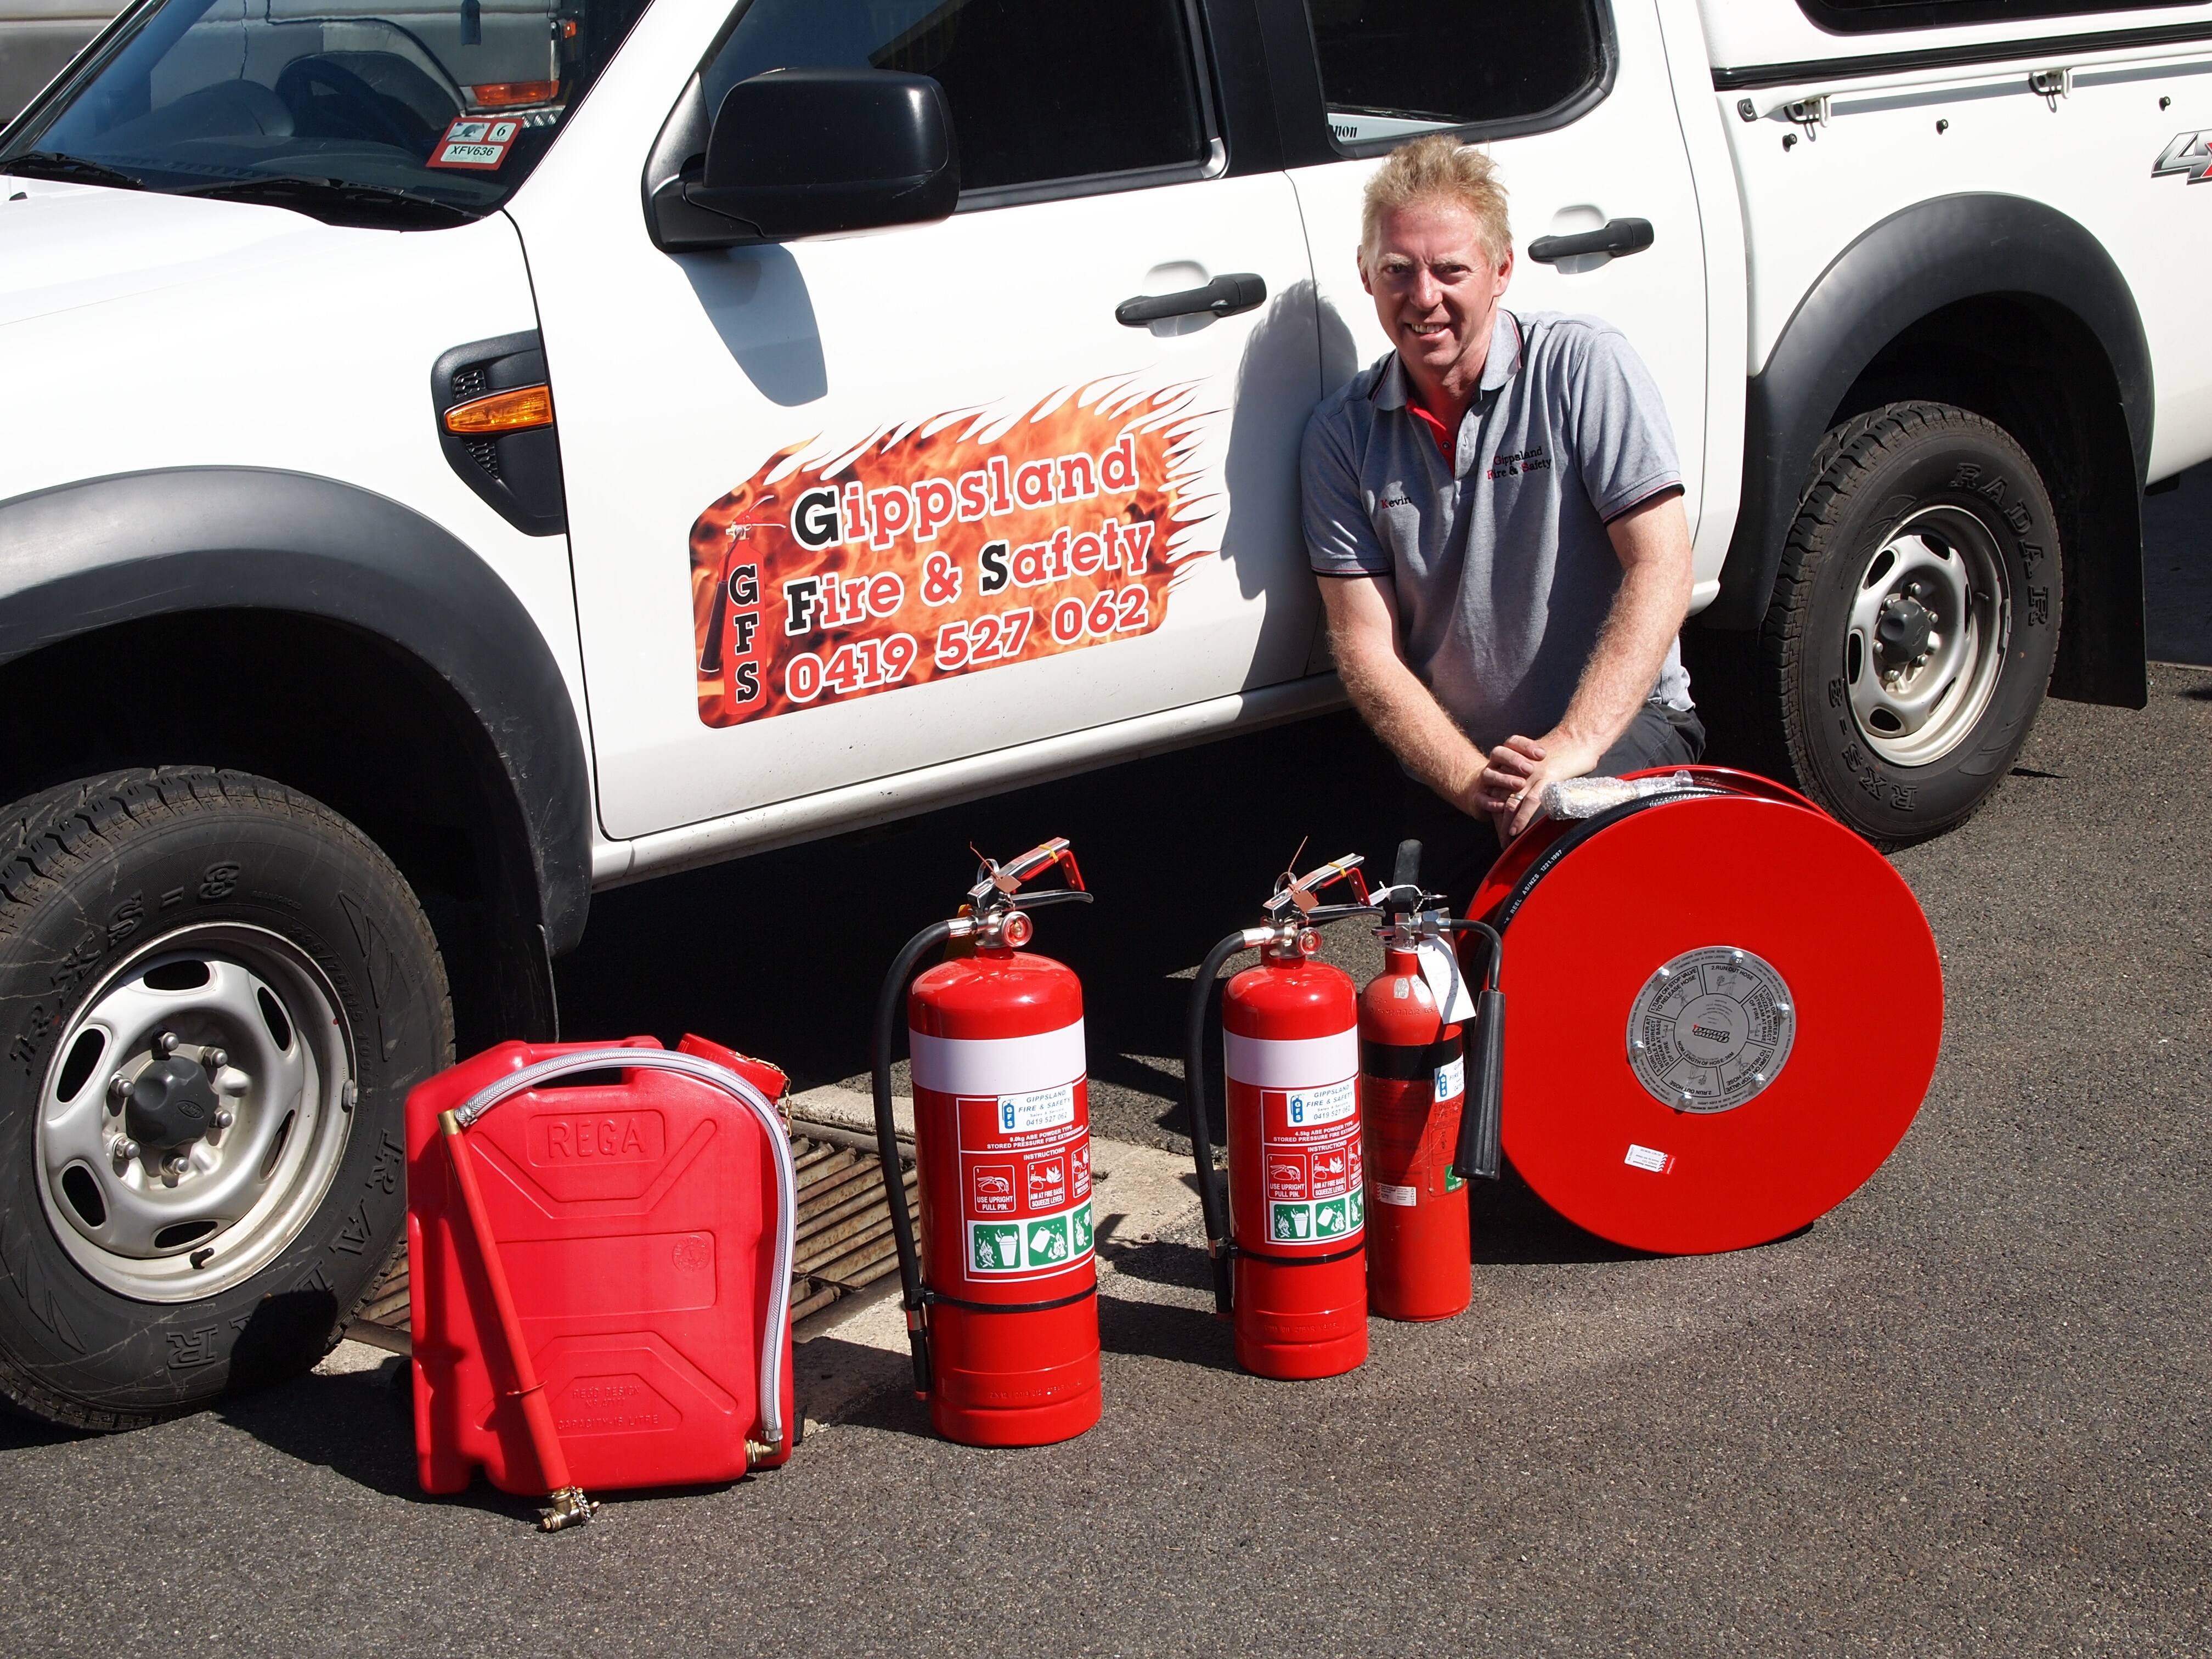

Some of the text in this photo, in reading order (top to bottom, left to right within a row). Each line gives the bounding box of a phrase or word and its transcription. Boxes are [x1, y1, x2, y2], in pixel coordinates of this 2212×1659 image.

[496, 124, 510, 137] 6
[450, 145, 495, 156] XFV636
[1493, 447, 1543, 466] Gippsland
[1487, 459, 1552, 481] Fire & Safety
[793, 435, 1137, 549] Gippsland
[1380, 495, 1413, 510] Kevin
[1949, 462, 2050, 628] RADAR
[786, 521, 1154, 635] Fire & Safety
[785, 586, 1147, 702] 0419 527 062
[1521, 873, 1540, 896] AS/NZS
[1740, 970, 1754, 981] HOSE
[1651, 994, 1663, 1011] 1.TURN
[1668, 977, 1681, 989] STOP
[1681, 968, 1697, 978] VALVE
[1662, 984, 1682, 1005] RELEASE
[1682, 975, 1696, 986] HOSE
[1753, 996, 1764, 1017] STREAM
[1759, 993, 1770, 1014] NOZZLE
[1771, 1007, 1776, 1015] ON
[1654, 1048, 1664, 1068] NOZZLE
[1658, 1045, 1669, 1066] STREAM
[1684, 1051, 1701, 1064] LENGTH
[1742, 1058, 1760, 1076] RELEASE
[1669, 1080, 1684, 1090] HOSE
[1726, 1075, 1741, 1086] HOSE
[1741, 1073, 1754, 1084] STOP
[1314, 1084, 1350, 1098] GIPPSLAND
[1725, 1081, 1741, 1092] VALVE
[1026, 1090, 1066, 1103] GIPPSLAND
[1047, 1097, 1071, 1108] SAFETY
[1333, 1091, 1353, 1103] SAFETY
[1045, 1115, 1056, 1124] 527
[1058, 1111, 1068, 1120] 062
[1039, 1129, 1061, 1138] POWDER
[1060, 1125, 1073, 1134] TYPE
[1323, 1125, 1344, 1133] POWDER
[1344, 1120, 1353, 1128] TYPE
[547, 1118, 646, 1160] REGA
[1013, 1139, 1045, 1148] PRESSURE
[1057, 1125, 1084, 1141] EXTINGUISHER
[1298, 1133, 1328, 1142] PRESSURE
[1307, 1140, 1347, 1153] INSTRUCTIONS
[1023, 1147, 1065, 1160] INSTRUCTIONS
[989, 1195, 1013, 1203] UPRIGHT
[1044, 1190, 1053, 1198] FIRE
[1053, 1187, 1063, 1197] BASE
[1315, 1188, 1333, 1197] SQUEEZE
[1031, 1195, 1063, 1207] SQUEEZE LEVER.
[605, 1385, 640, 1397] DESIGN
[629, 1414, 658, 1426] LITRE
